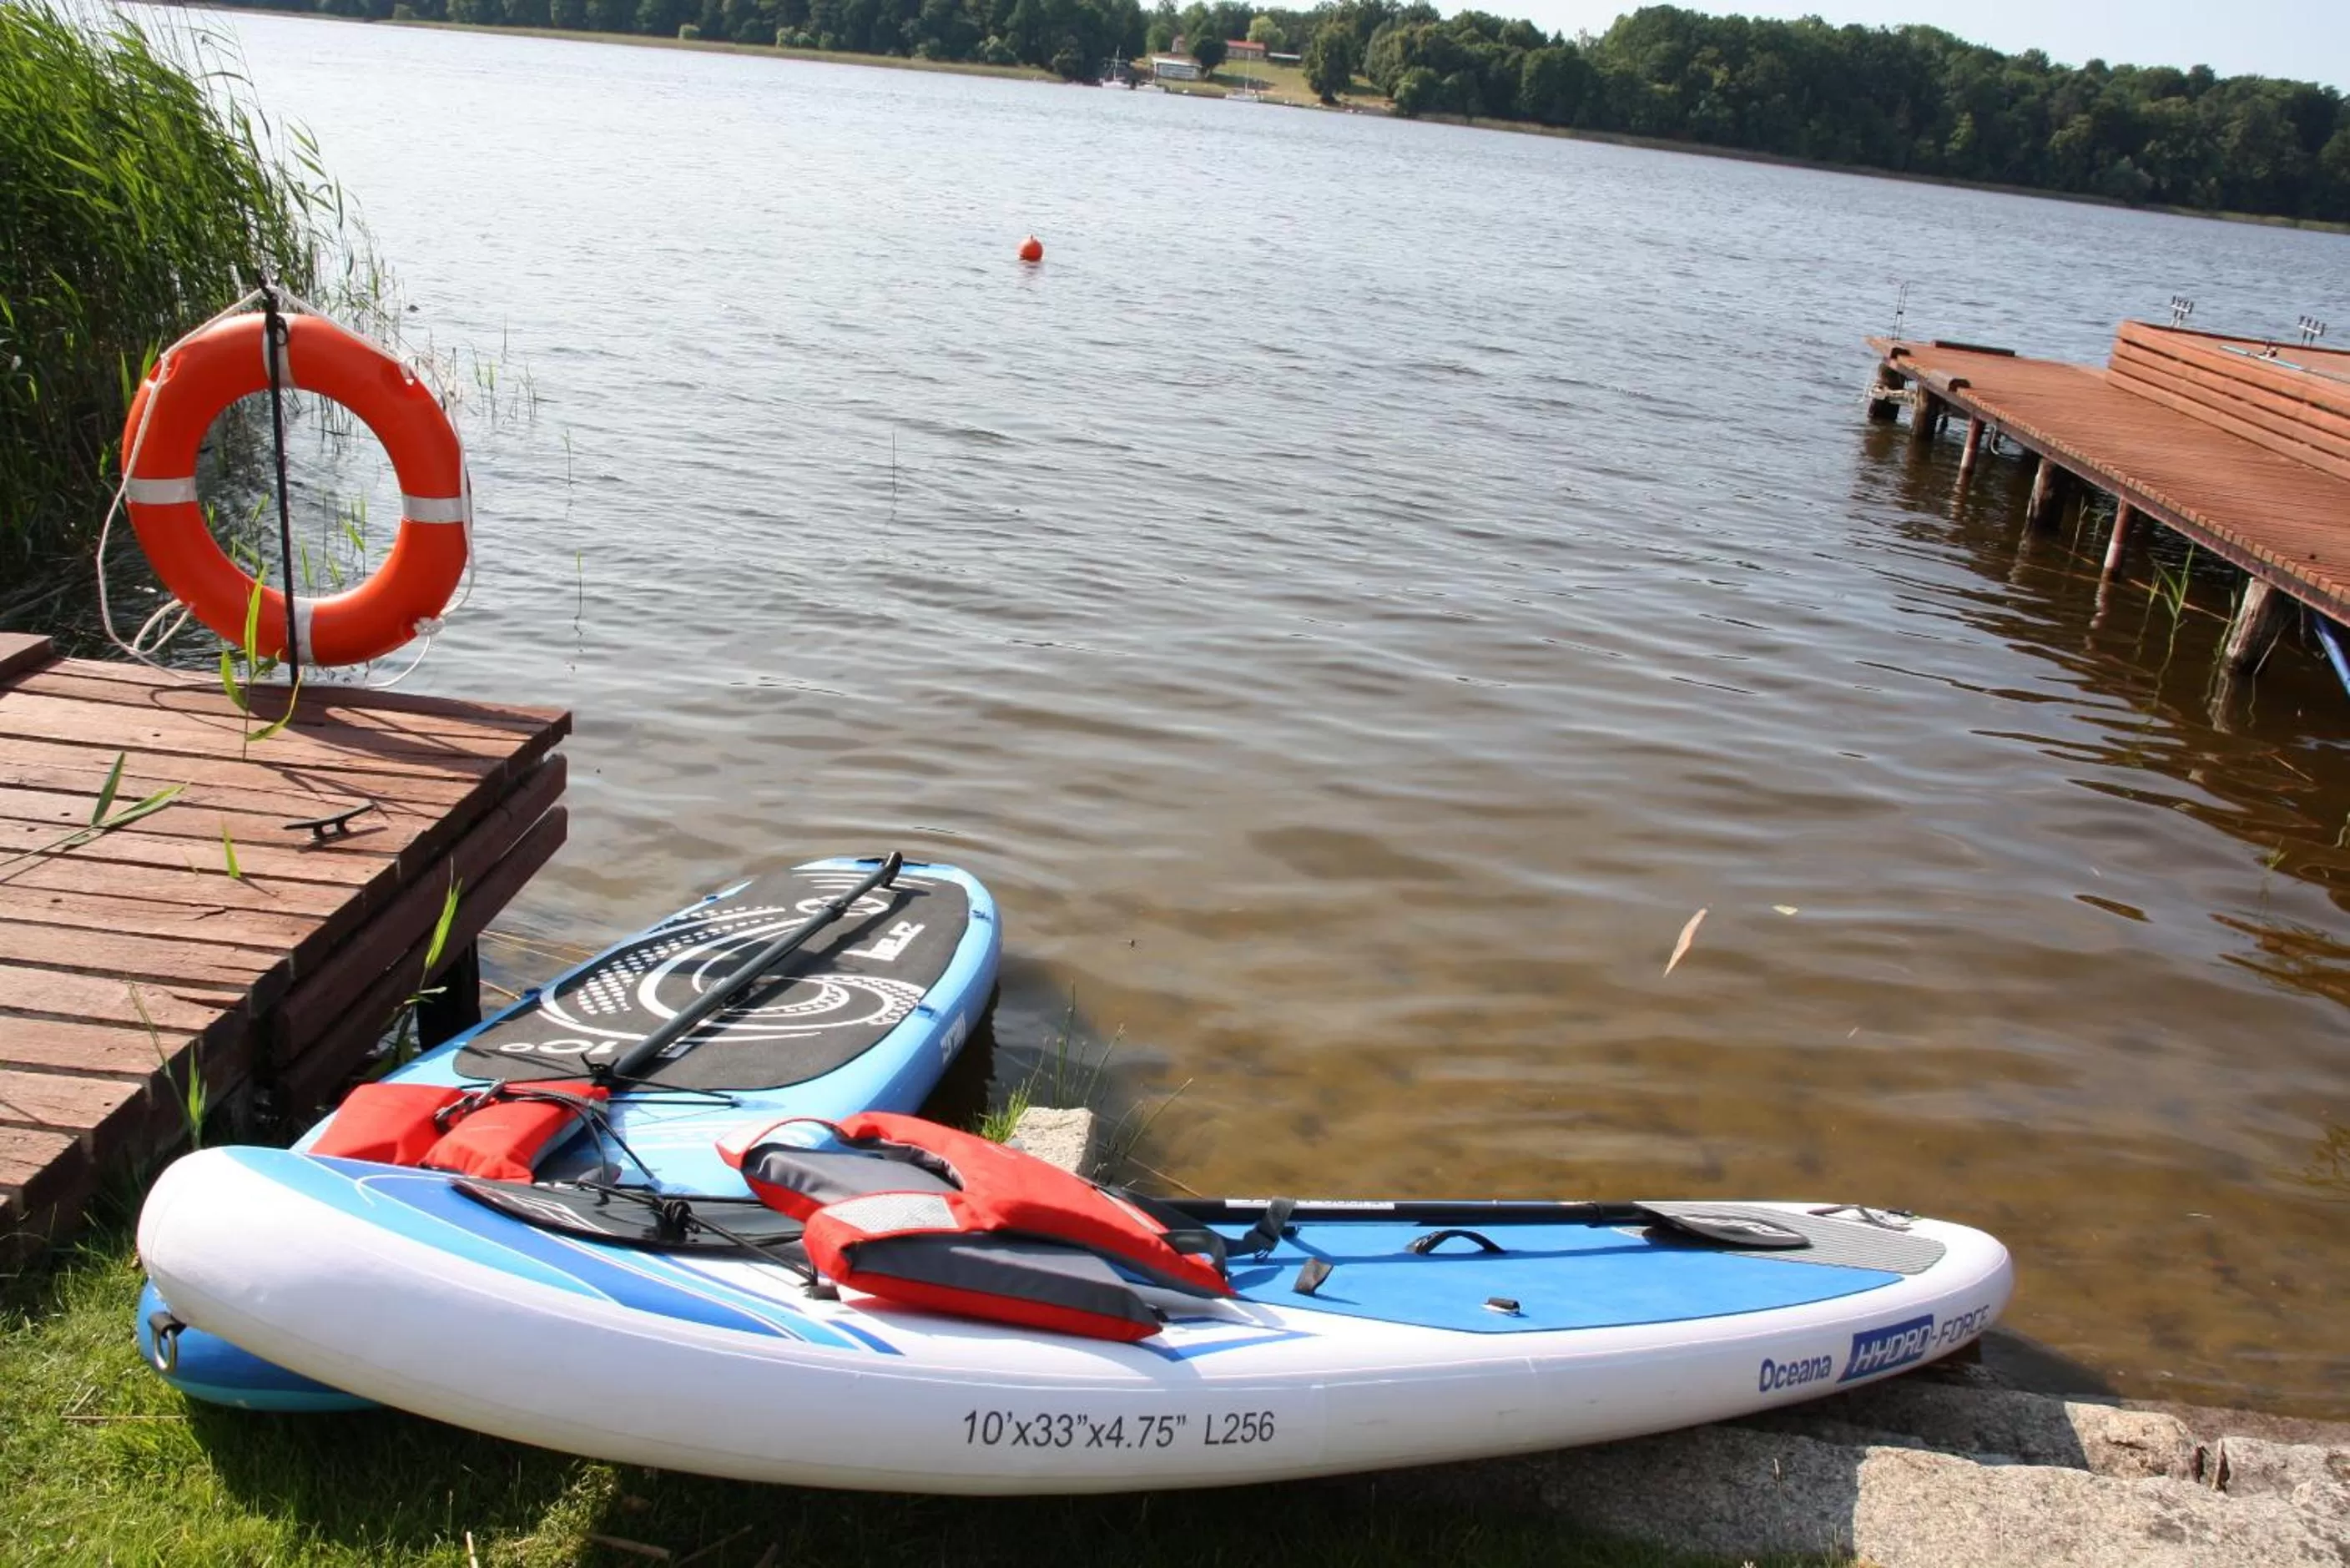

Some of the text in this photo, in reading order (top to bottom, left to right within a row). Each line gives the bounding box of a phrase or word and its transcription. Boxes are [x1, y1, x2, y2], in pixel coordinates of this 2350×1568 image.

[1758, 1304, 1990, 1393] Oceana HYDRO-FORCE
[1203, 1410, 1275, 1445] L256
